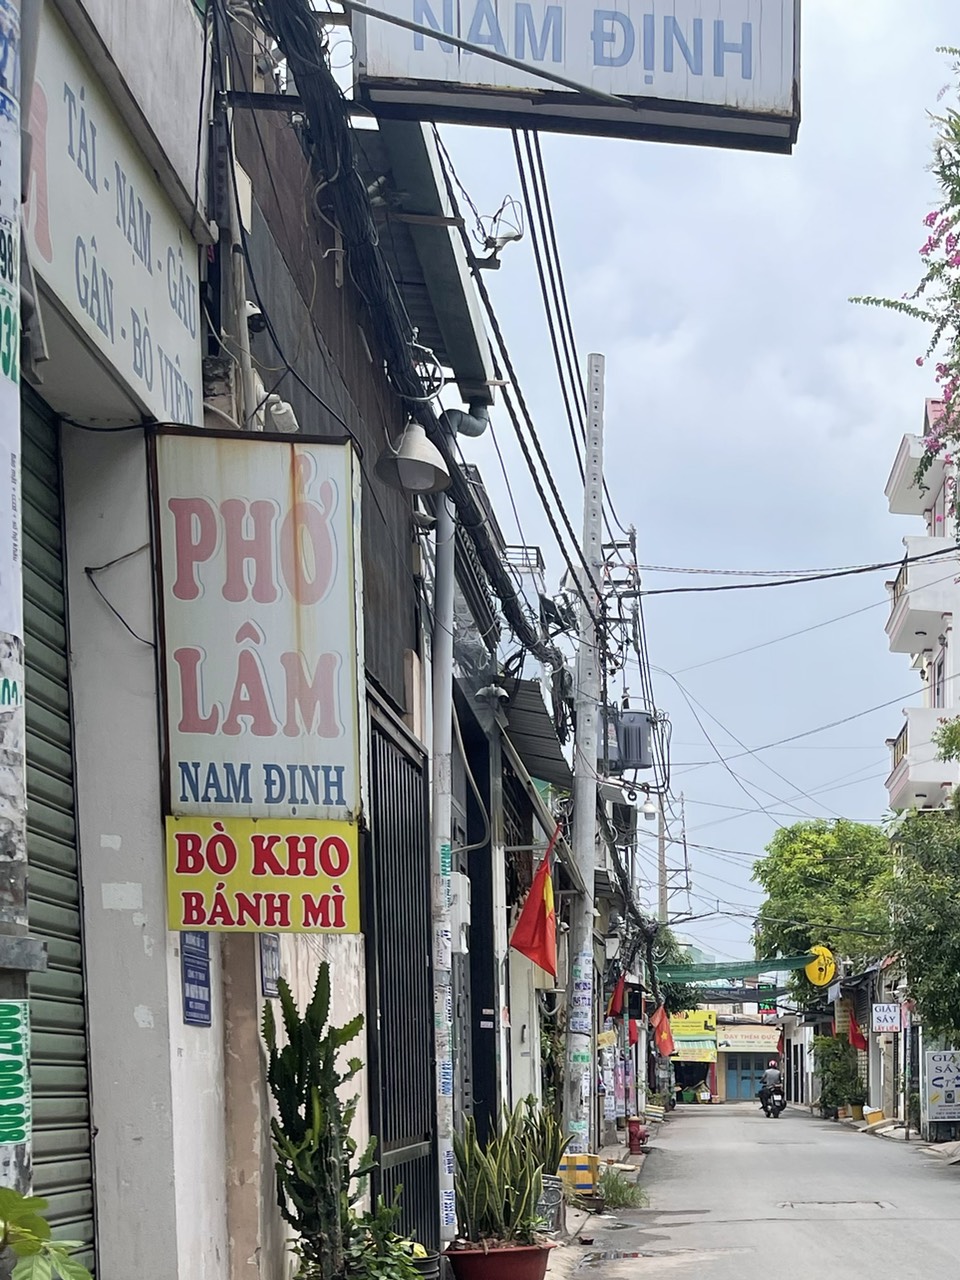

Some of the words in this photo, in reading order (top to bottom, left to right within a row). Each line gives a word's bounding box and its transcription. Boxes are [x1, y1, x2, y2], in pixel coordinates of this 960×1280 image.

[413, 0, 562, 63] NAM
[590, 9, 753, 84] ĐỊNH
[114, 159, 153, 277] NẠM
[75, 234, 114, 345] GÂN
[130, 307, 154, 392] BÒ
[157, 344, 194, 426] VIÊN
[167, 453, 338, 606] PHỞ
[172, 620, 341, 739] LÂM
[178, 761, 252, 804] NAM
[264, 764, 346, 816] ĐỊNH
[175, 822, 237, 875] BÒ
[250, 834, 350, 878] KHO
[182, 882, 290, 928] BÁNH
[302, 885, 347, 929] MÌ
